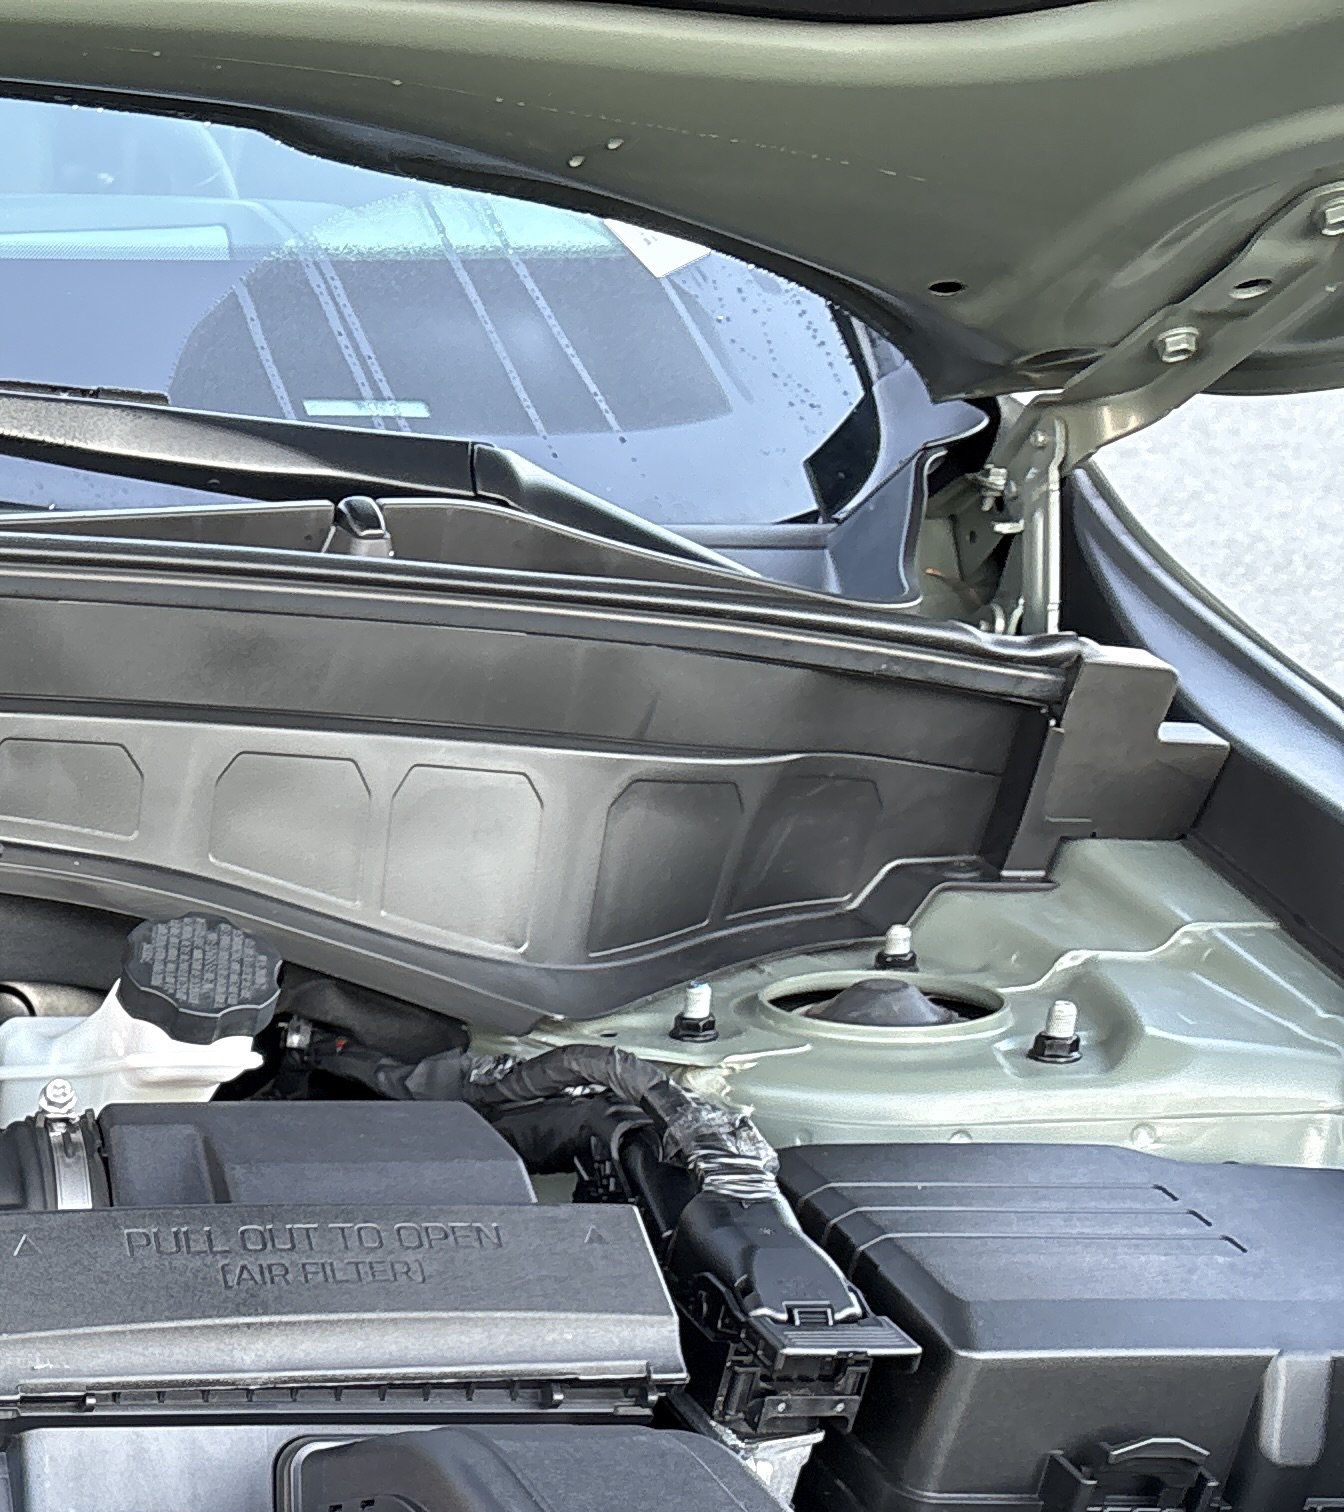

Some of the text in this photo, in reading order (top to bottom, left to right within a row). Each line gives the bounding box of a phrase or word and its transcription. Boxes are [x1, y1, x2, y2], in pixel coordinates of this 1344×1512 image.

[123, 1222, 504, 1257] PULL OUT TO OPEN
